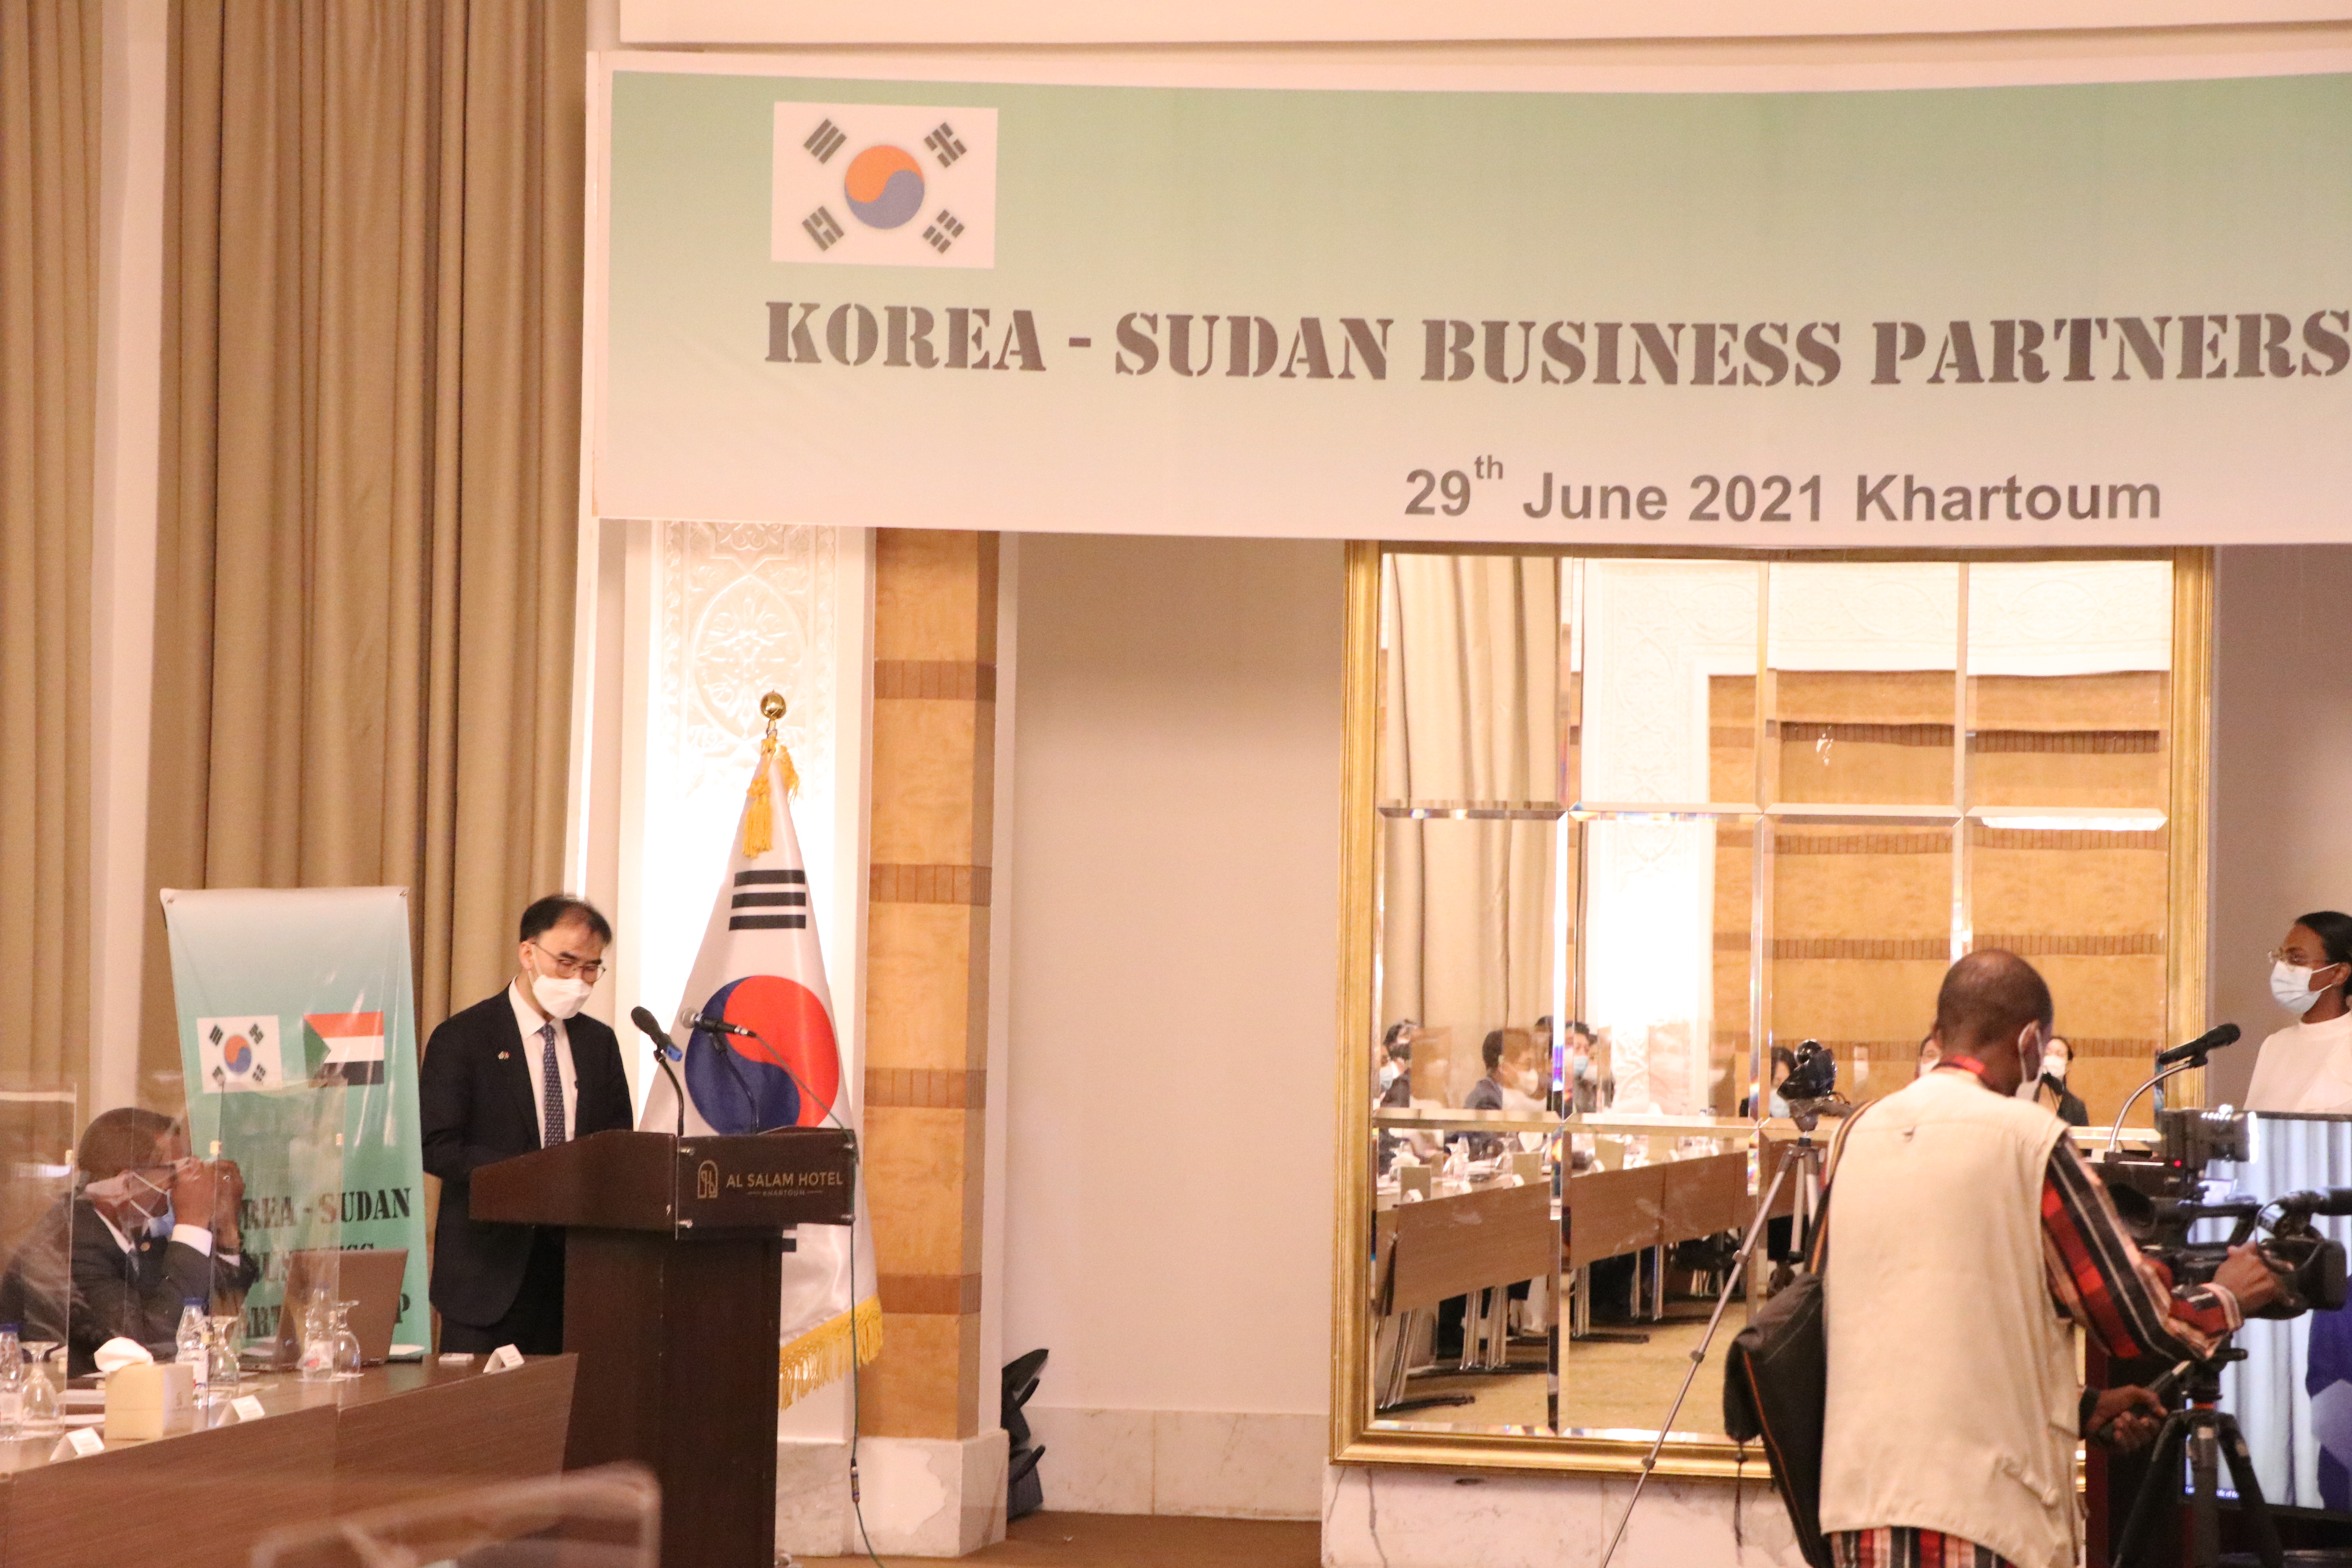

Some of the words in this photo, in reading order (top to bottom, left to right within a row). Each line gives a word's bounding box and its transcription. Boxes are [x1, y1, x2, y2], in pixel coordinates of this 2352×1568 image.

[765, 301, 1047, 372] KOREA
[1069, 337, 1091, 348] -
[1115, 312, 1394, 380] SUDAN
[1421, 319, 1841, 387] BUSINESS
[1871, 310, 2351, 385] PARTNERS
[1405, 454, 1504, 516] 29th
[1523, 472, 1668, 521] June
[1689, 474, 1821, 522] 2021
[1856, 474, 2161, 521] Khartoum
[318, 1187, 411, 1224] SUDAN
[726, 1174, 743, 1188] AL
[747, 1172, 794, 1188] SALAM
[799, 1171, 844, 1186] HOTEL
